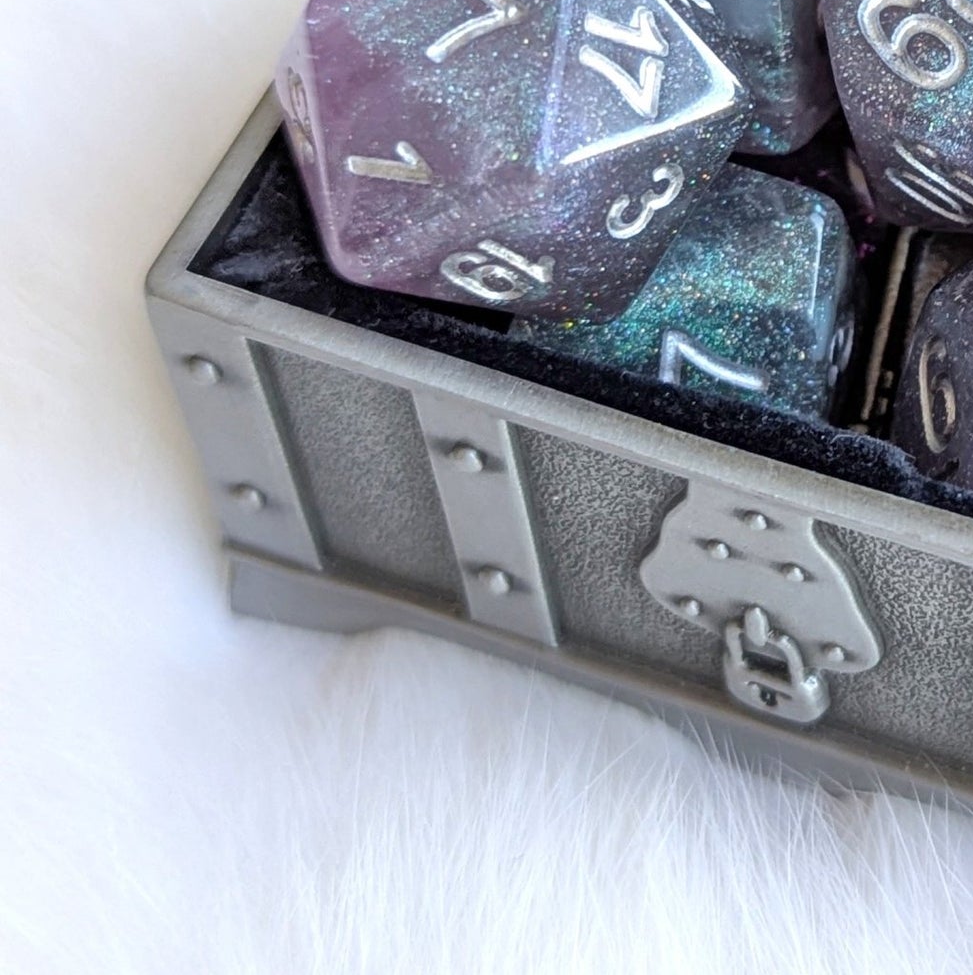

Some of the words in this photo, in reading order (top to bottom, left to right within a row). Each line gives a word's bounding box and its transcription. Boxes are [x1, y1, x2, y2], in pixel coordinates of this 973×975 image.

[577, 5, 669, 121] 17
[347, 140, 432, 185] 1
[605, 162, 685, 240] 3
[439, 237, 556, 301] 19
[658, 327, 771, 392] 7
